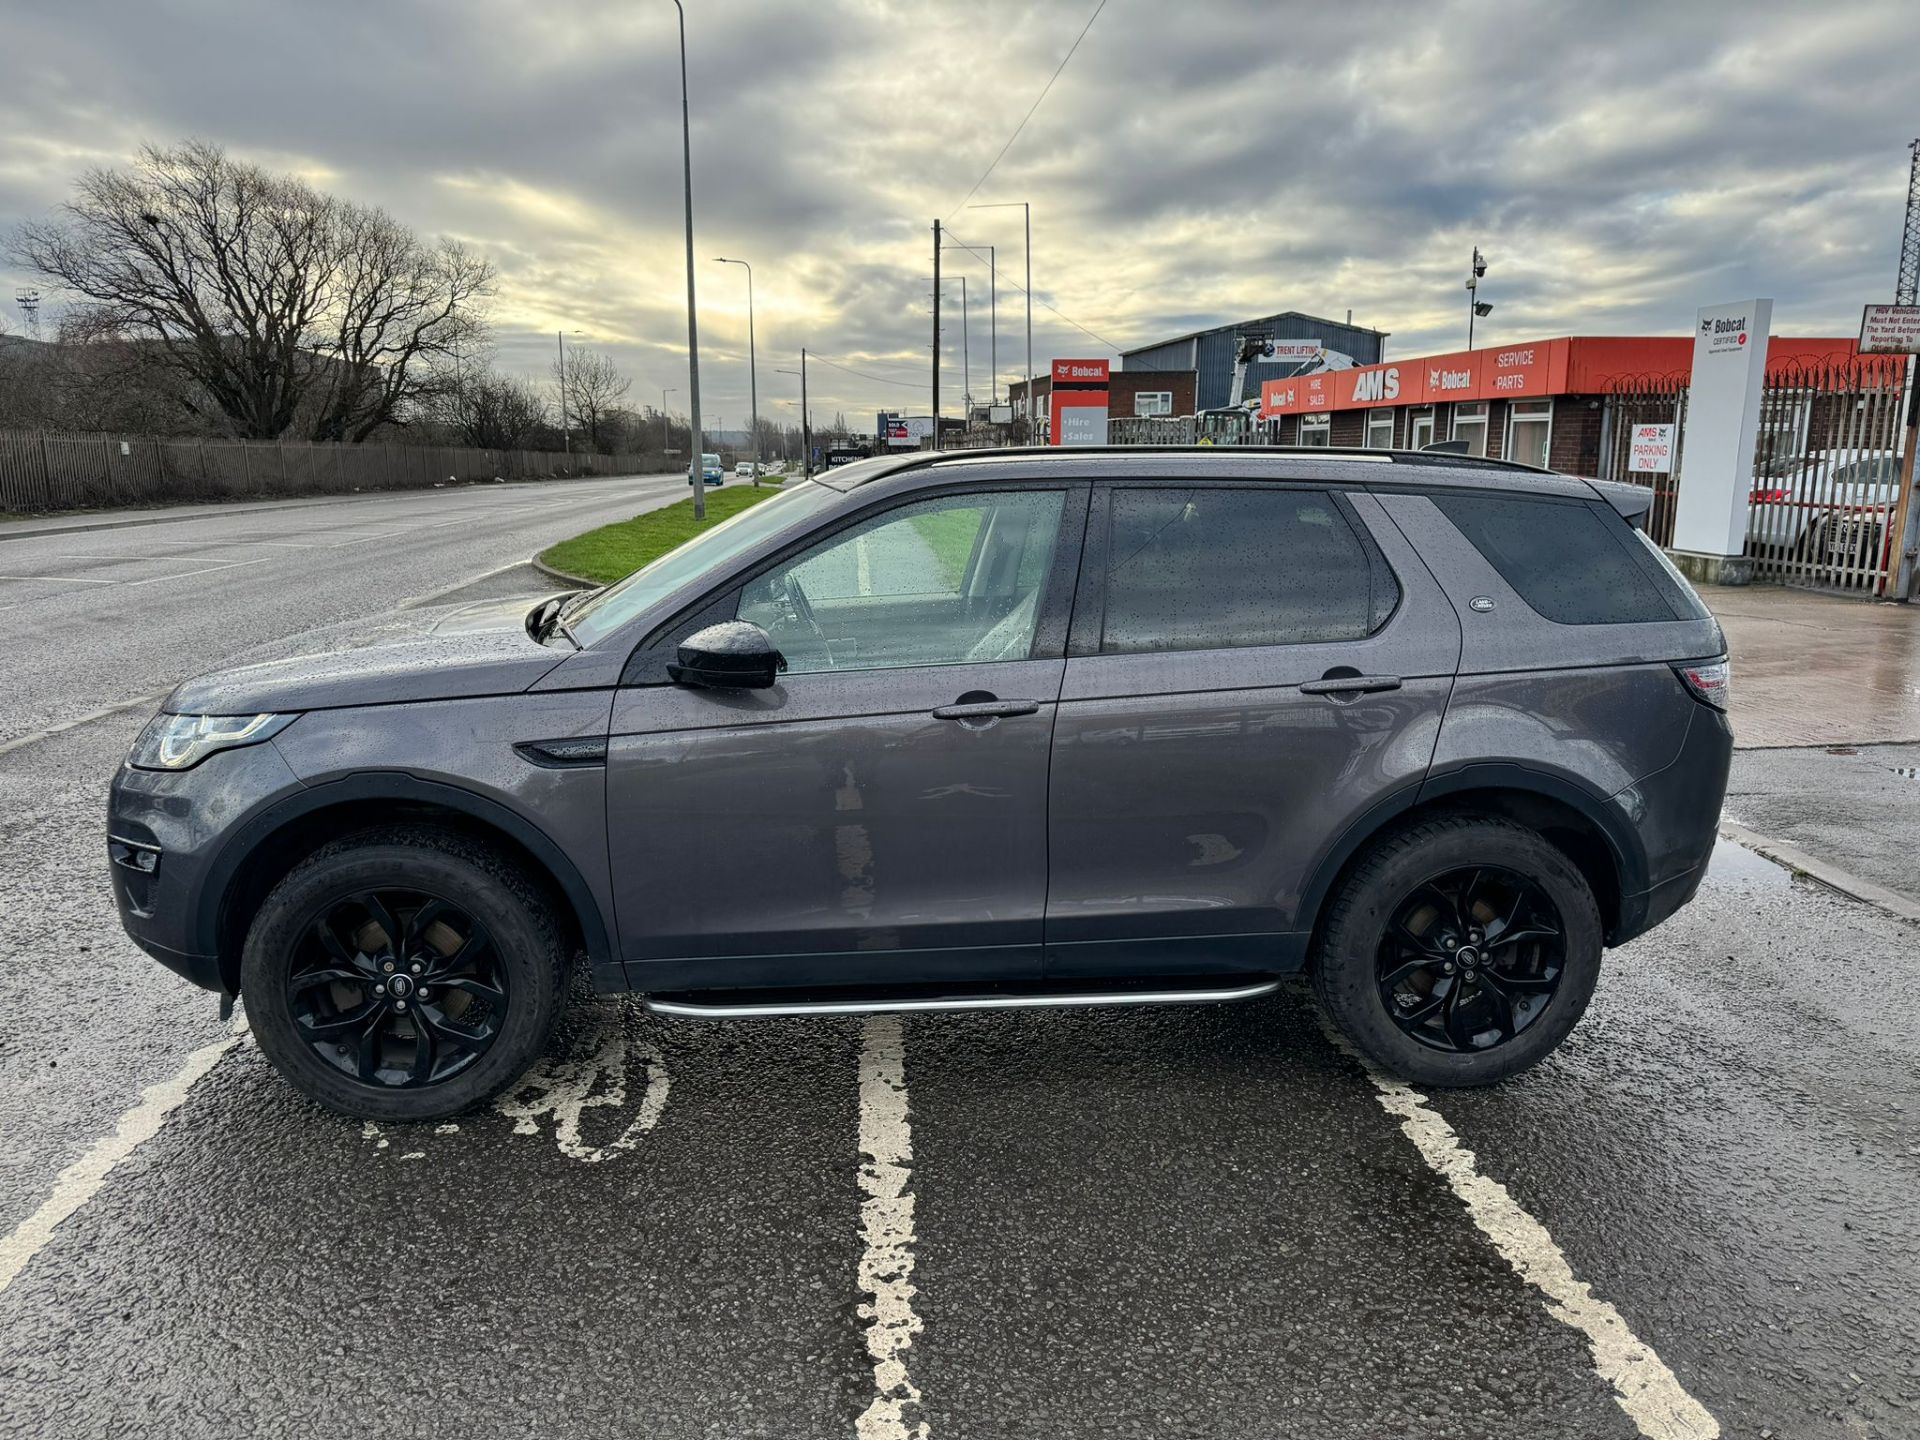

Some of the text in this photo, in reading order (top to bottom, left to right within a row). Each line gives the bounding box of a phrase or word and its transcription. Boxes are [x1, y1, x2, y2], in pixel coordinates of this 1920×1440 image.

[1714, 316, 1746, 334] Bobcat
[1870, 336, 1904, 344] Reporting
[1276, 346, 1295, 354] TRENT
[1498, 350, 1534, 368] SERVICE
[1072, 366, 1104, 376] Bobcat
[1352, 368, 1400, 402] AMS
[1441, 369, 1471, 390] Bobcat
[1496, 374, 1524, 390] PARTS
[1068, 418, 1090, 426] Hire
[1068, 432, 1094, 440] Sales
[1638, 428, 1657, 438] AMS
[1634, 444, 1668, 456] PARKING
[1638, 458, 1658, 469] ONLY
